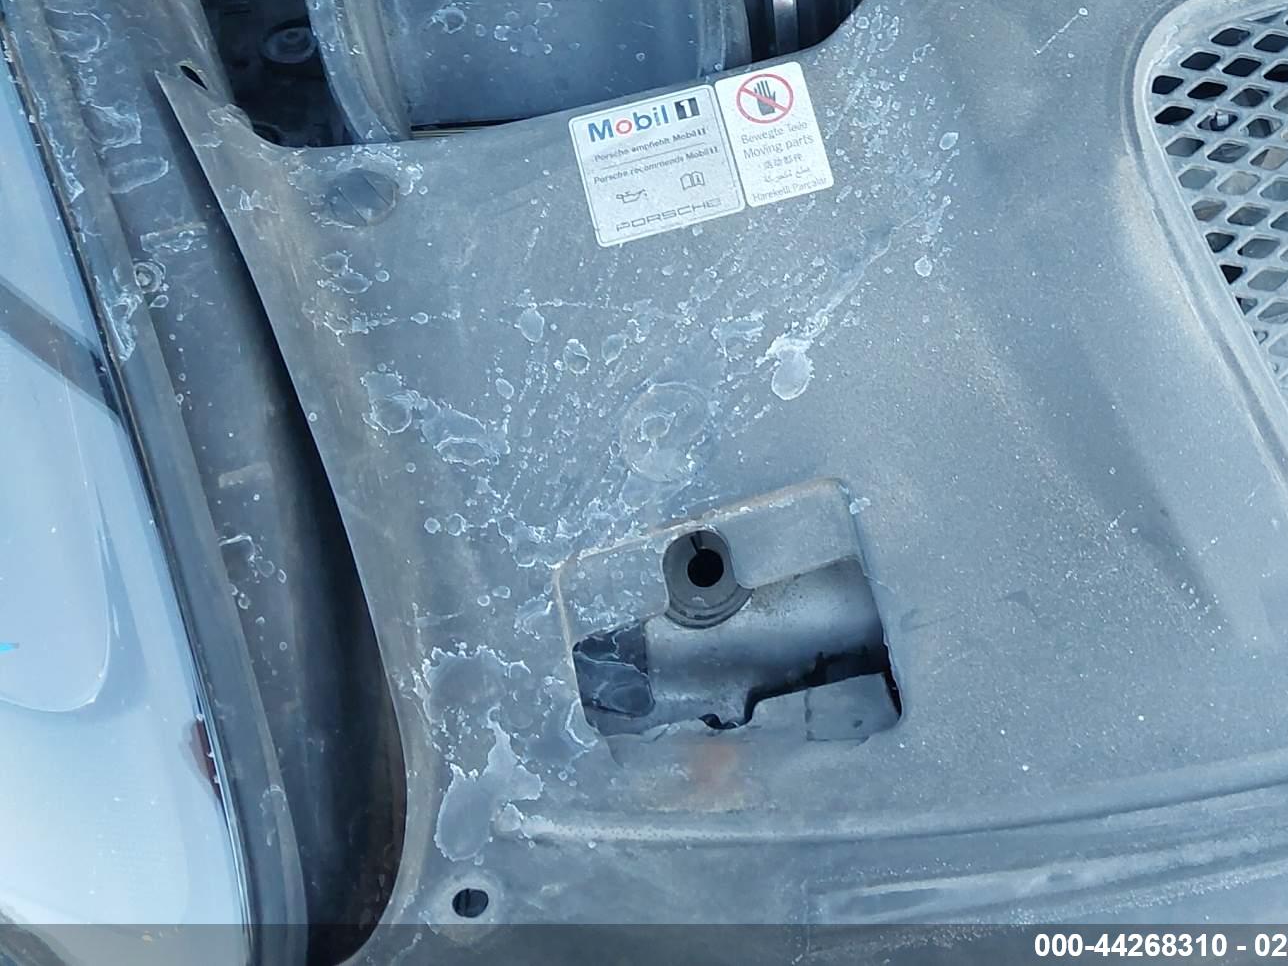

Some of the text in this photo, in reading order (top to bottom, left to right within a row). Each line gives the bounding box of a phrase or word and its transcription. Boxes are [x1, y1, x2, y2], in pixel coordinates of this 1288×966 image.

[588, 105, 669, 142] Mobil
[743, 134, 815, 159] Moving parts
[616, 197, 722, 232] PORSCHE
